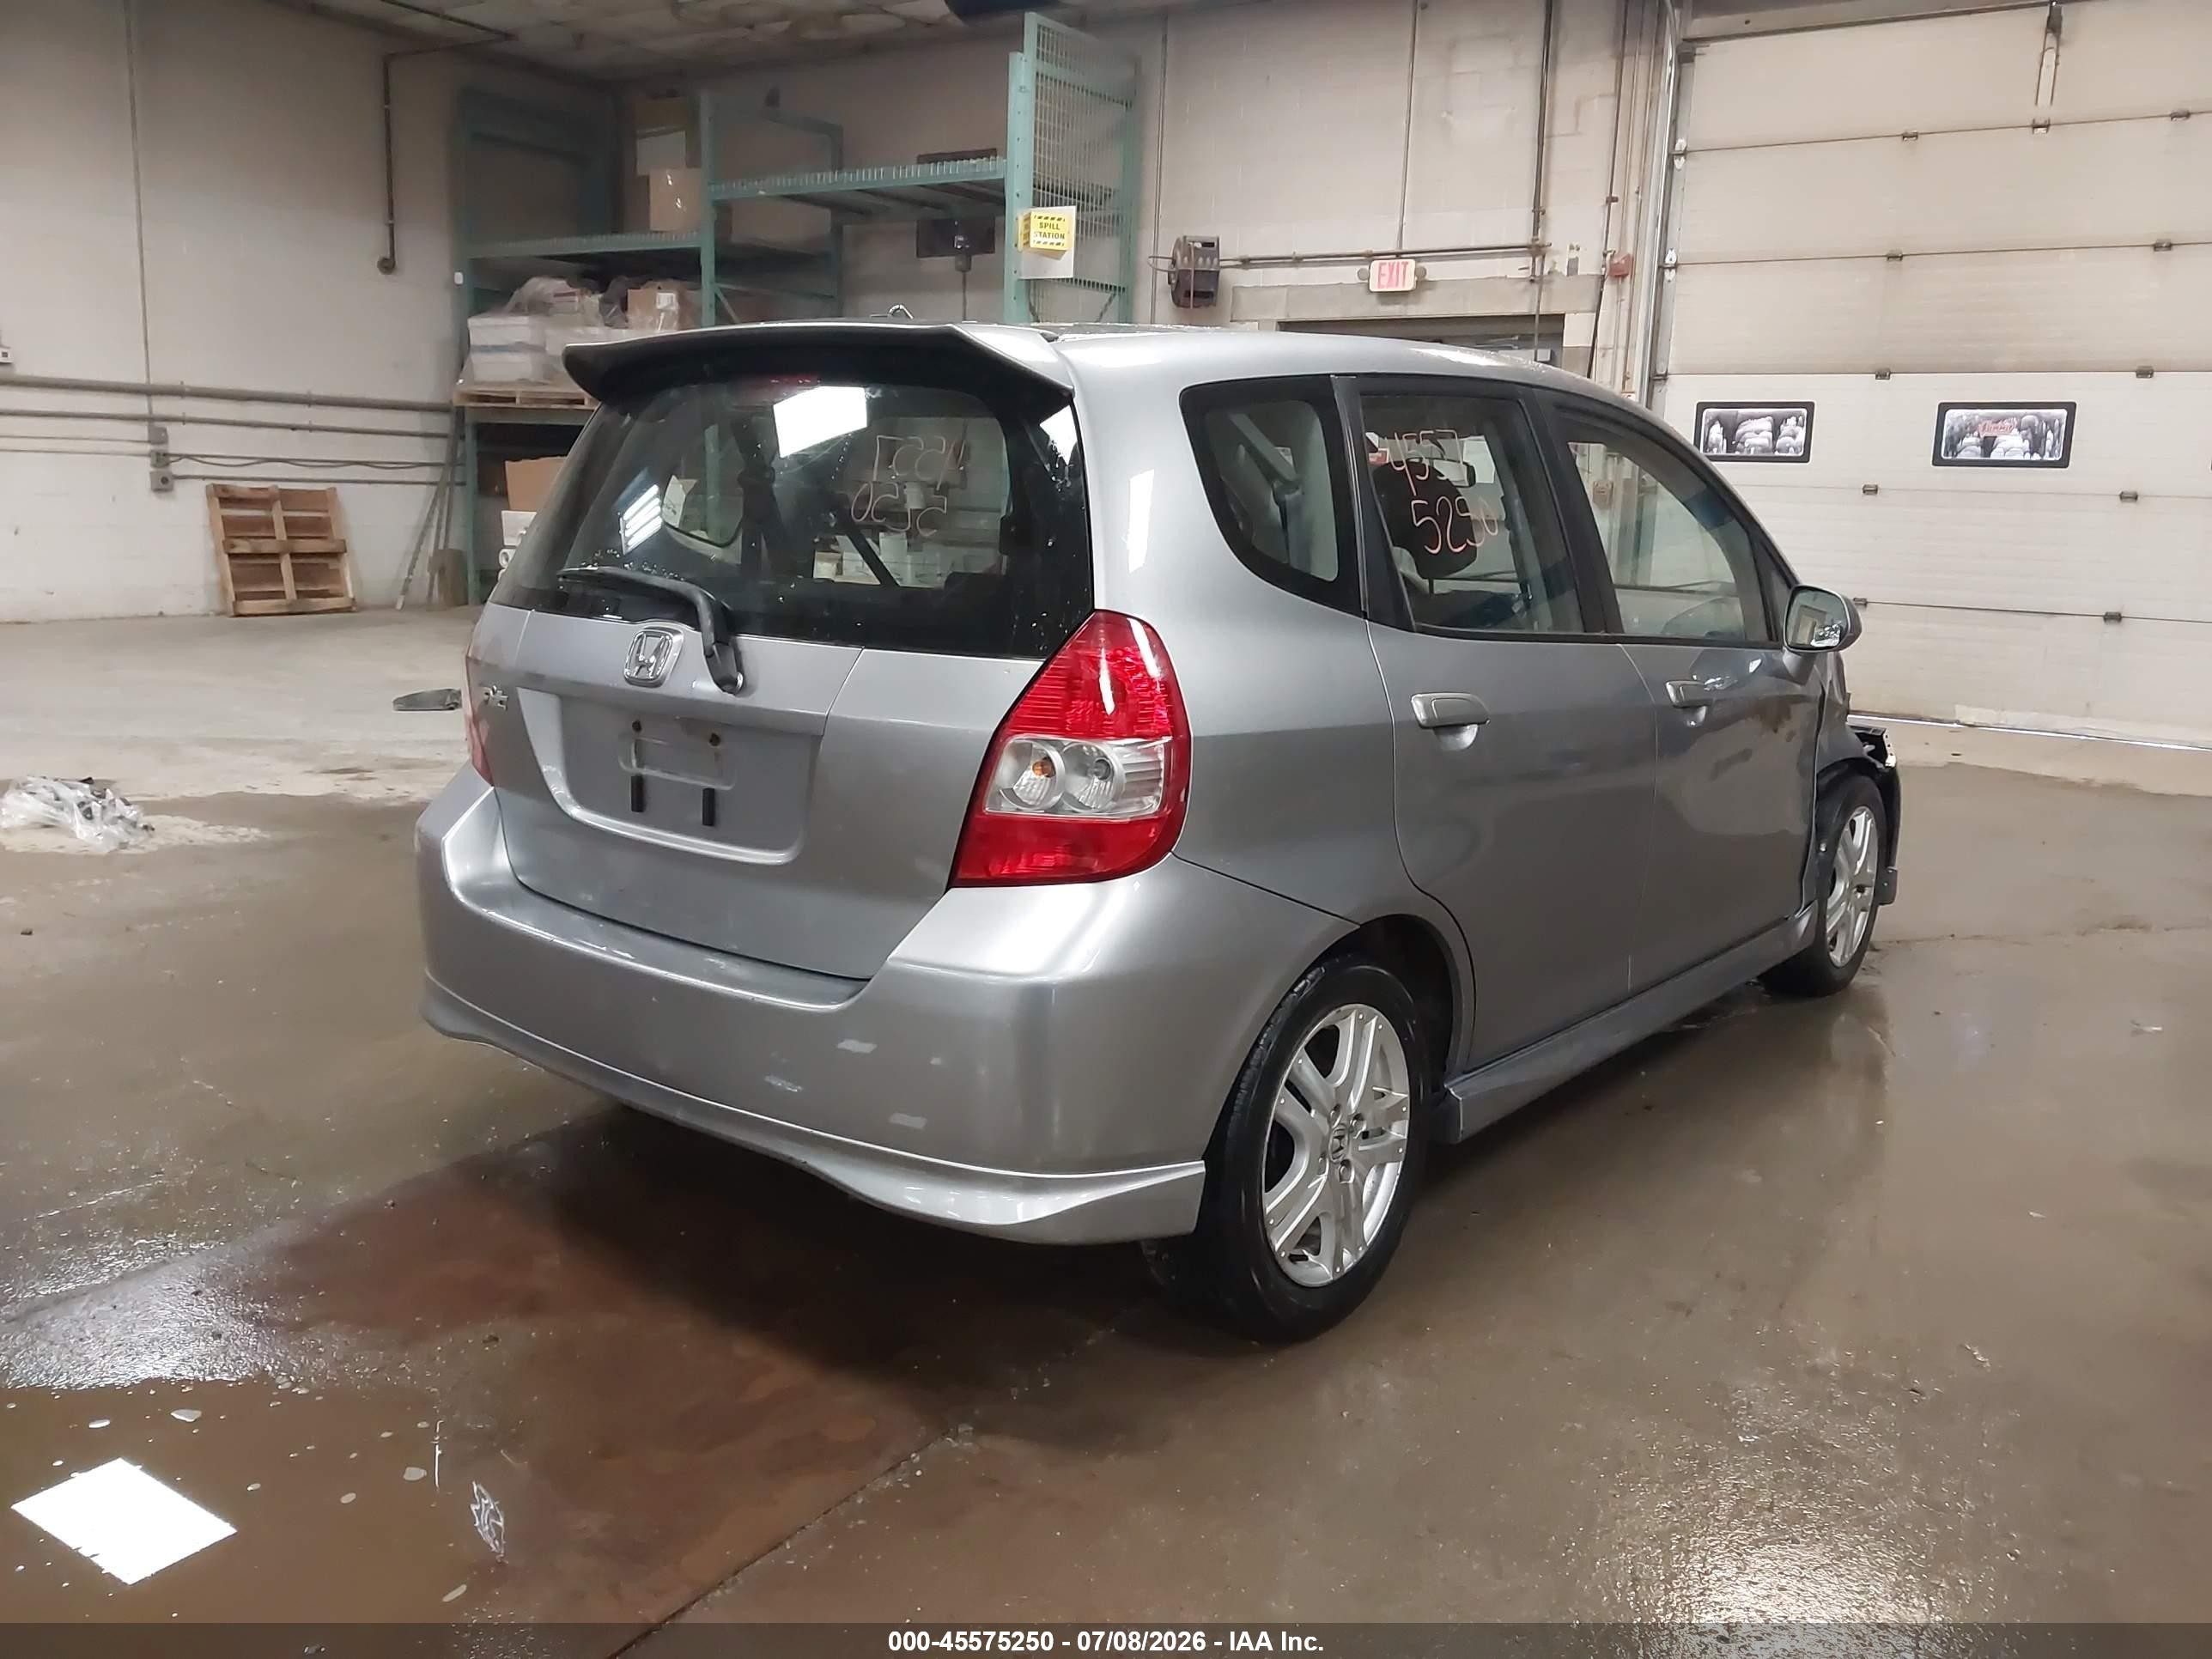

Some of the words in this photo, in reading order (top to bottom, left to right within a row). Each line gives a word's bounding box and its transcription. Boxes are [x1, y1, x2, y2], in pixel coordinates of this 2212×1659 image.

[1038, 222, 1061, 230] SPILL
[1033, 231, 1066, 240] STATION
[1376, 261, 1410, 289] EXIT
